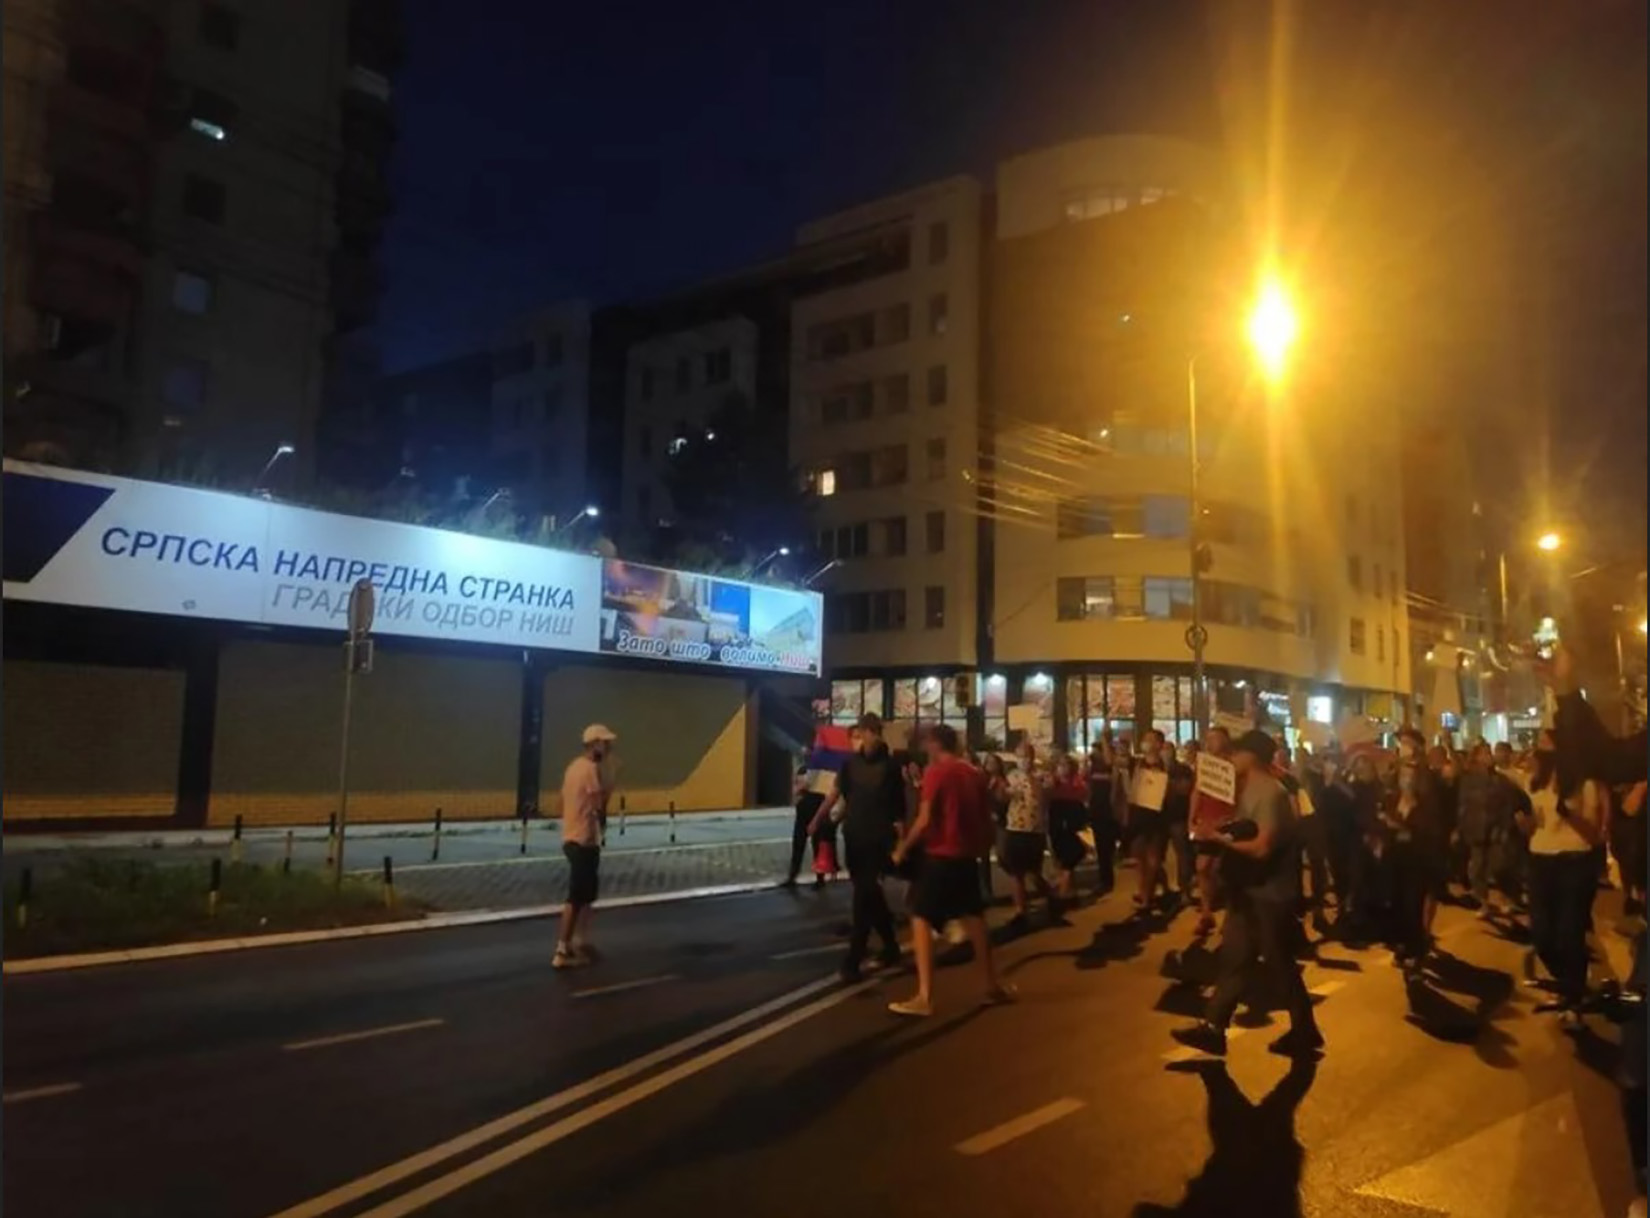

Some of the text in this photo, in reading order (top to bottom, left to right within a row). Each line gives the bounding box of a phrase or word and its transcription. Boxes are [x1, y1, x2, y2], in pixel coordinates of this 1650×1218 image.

[101, 526, 575, 611] СРПСКА НАПРЕДНА СТРАНКА
[271, 583, 575, 637] ГРАДКИ ОДБОР НИШ
[617, 630, 668, 656] Зато
[669, 641, 712, 661] што
